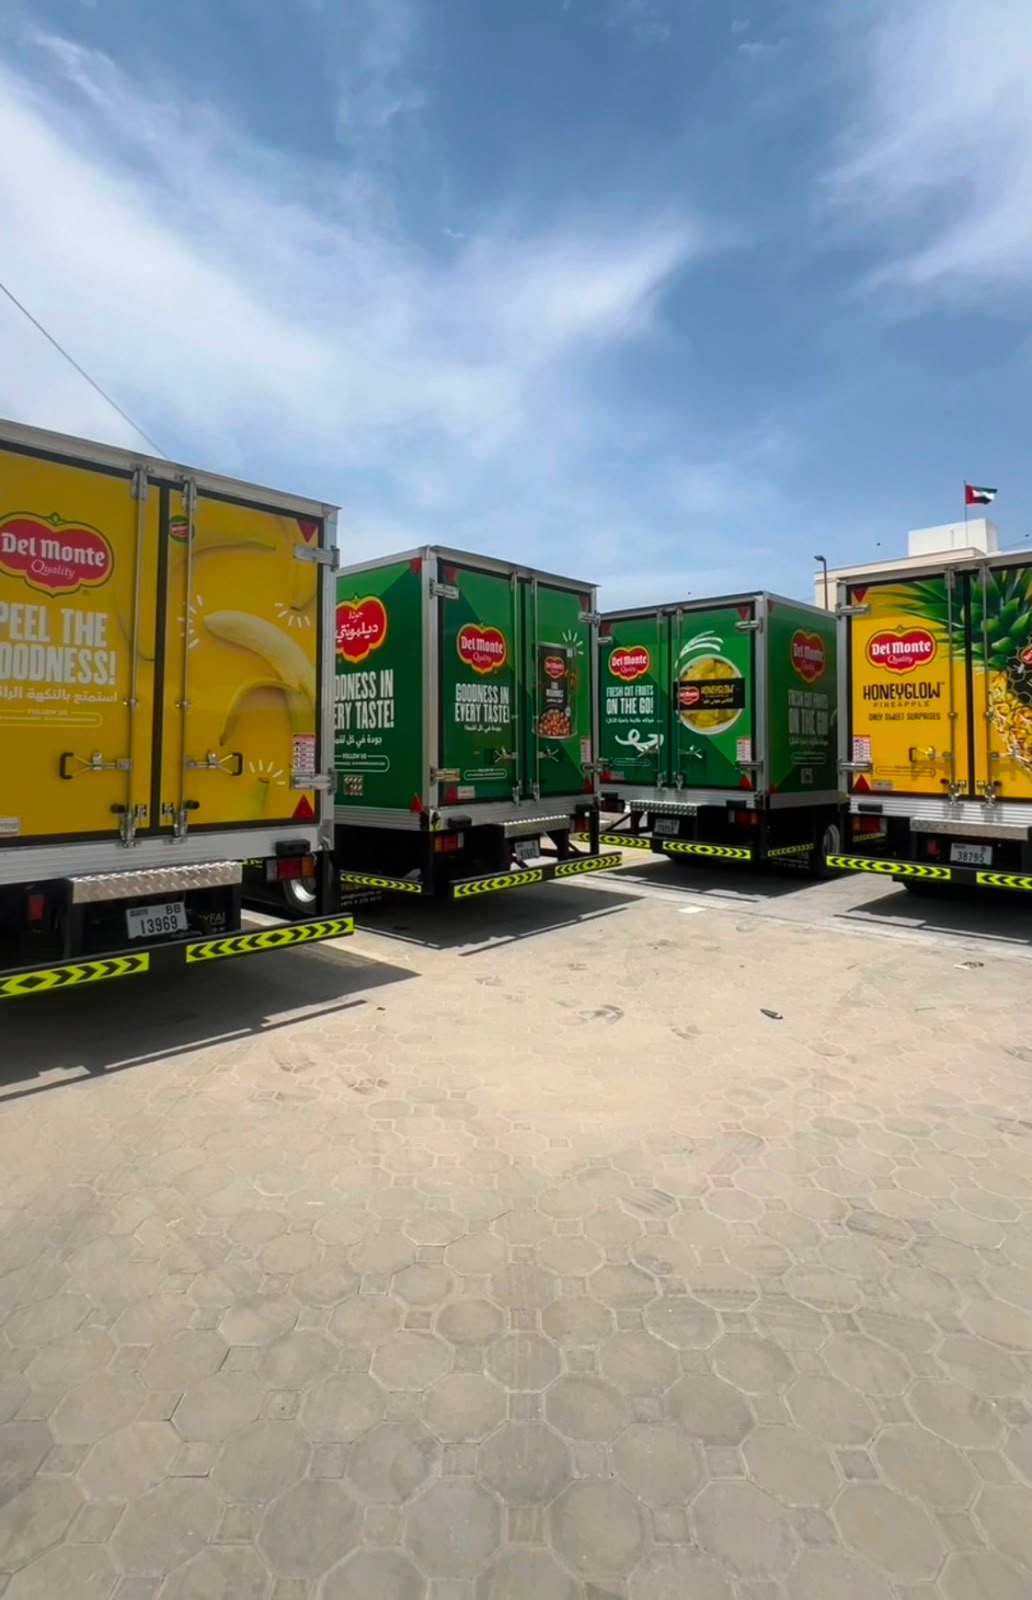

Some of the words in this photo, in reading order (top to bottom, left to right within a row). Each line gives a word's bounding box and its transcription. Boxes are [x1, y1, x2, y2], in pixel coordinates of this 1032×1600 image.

[1, 532, 36, 557] Del
[40, 538, 106, 567] Monte
[31, 559, 76, 579] Quality
[61, 608, 109, 647] THE
[461, 636, 475, 650] Del
[476, 638, 503, 654] Monte
[872, 643, 890, 655] Del
[892, 640, 932, 654] Monte
[612, 656, 623, 666] Del
[623, 654, 647, 665] Monte
[887, 654, 914, 665] Quality
[380, 669, 394, 698] IN
[606, 686, 624, 698] FRESH
[635, 684, 654, 697] FRUITS
[455, 683, 498, 705] GOODNESS
[499, 685, 510, 705] IN
[355, 699, 395, 730] TASTE!
[454, 702, 481, 722] EVERY
[483, 703, 511, 724] TASTE!
[606, 697, 619, 715] ON
[619, 697, 638, 715] THE
[639, 696, 654, 715] GO!
[869, 712, 883, 721] ONLY
[885, 712, 905, 721] SWEET
[907, 711, 941, 721] SURPRISES
[140, 915, 178, 935] 13969
